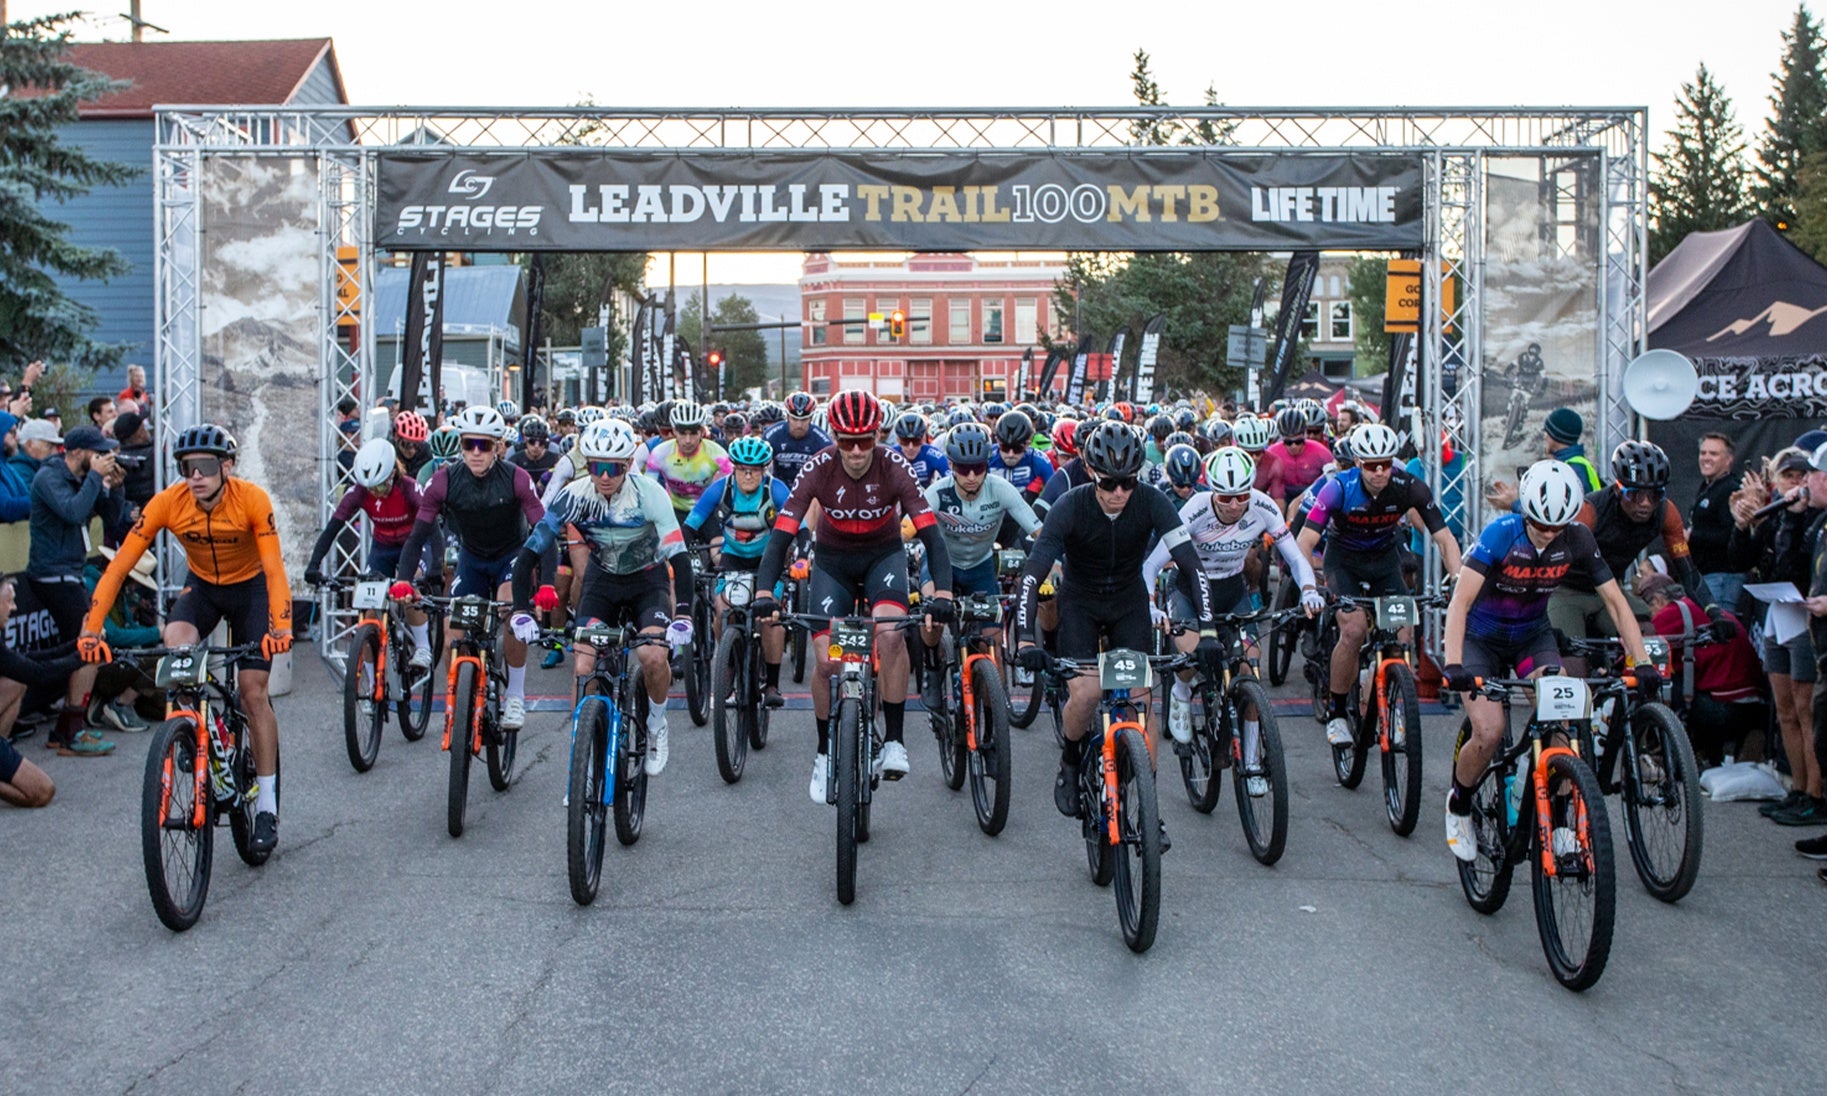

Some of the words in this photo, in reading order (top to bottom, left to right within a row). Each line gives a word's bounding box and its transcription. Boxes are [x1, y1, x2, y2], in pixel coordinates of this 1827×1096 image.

[568, 183, 851, 222] LEADVILLE
[856, 184, 1011, 223] TRAIL
[1012, 182, 1106, 225] 100
[1106, 184, 1221, 223] MTB
[397, 205, 543, 227] STAGES
[396, 227, 539, 237] CYCLING
[824, 504, 893, 520] TOYOTA
[366, 587, 377, 597] 11
[461, 605, 479, 617] 35
[1017, 586, 1030, 630] PIVOT
[1387, 603, 1406, 615] 42
[590, 634, 609, 646] 53
[837, 633, 867, 648] 342
[170, 656, 194, 670] 49
[1113, 659, 1137, 671] 45
[1552, 686, 1575, 700] 25
